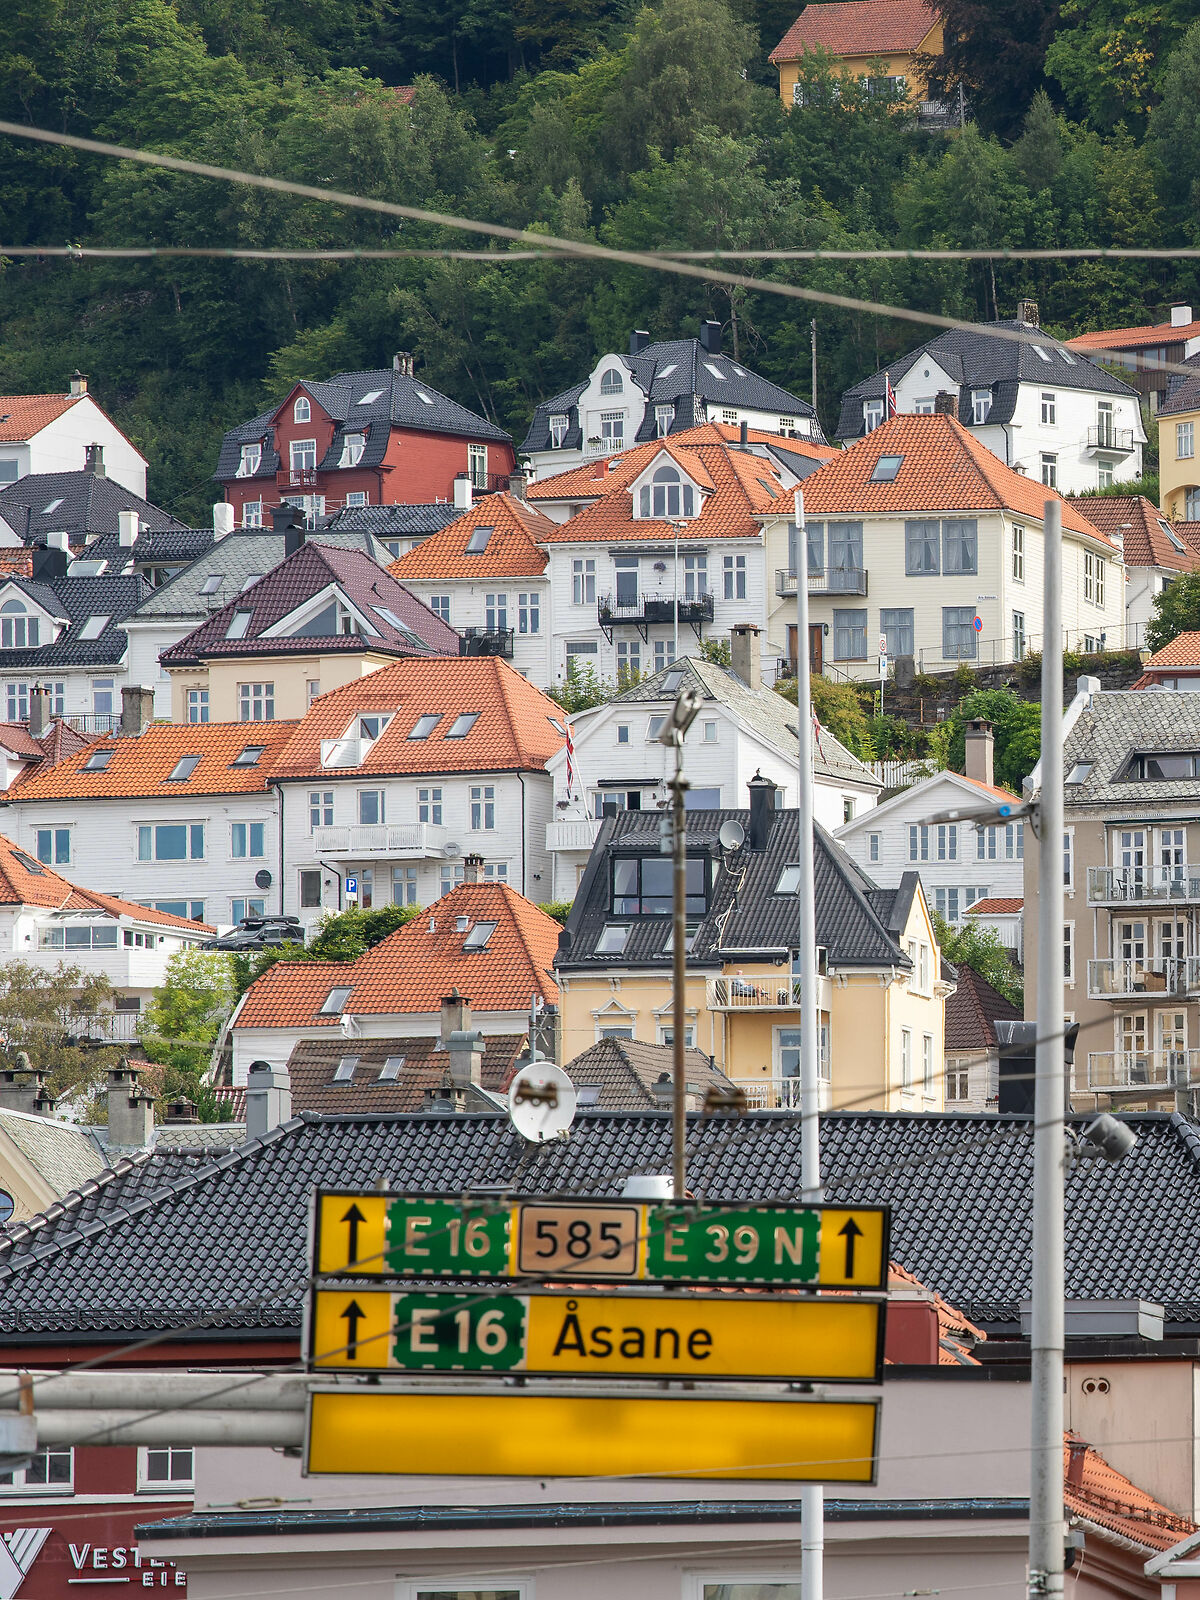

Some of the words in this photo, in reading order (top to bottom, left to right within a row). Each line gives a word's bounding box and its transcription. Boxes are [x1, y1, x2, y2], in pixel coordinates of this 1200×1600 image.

[405, 1216, 431, 1256] E
[446, 1217, 491, 1258] 16
[535, 1220, 623, 1260] 585
[664, 1223, 689, 1262] E
[705, 1224, 760, 1264] 39
[774, 1226, 804, 1265] N
[410, 1308, 440, 1352] E
[454, 1309, 508, 1355] 16
[552, 1299, 713, 1360] Åsane
